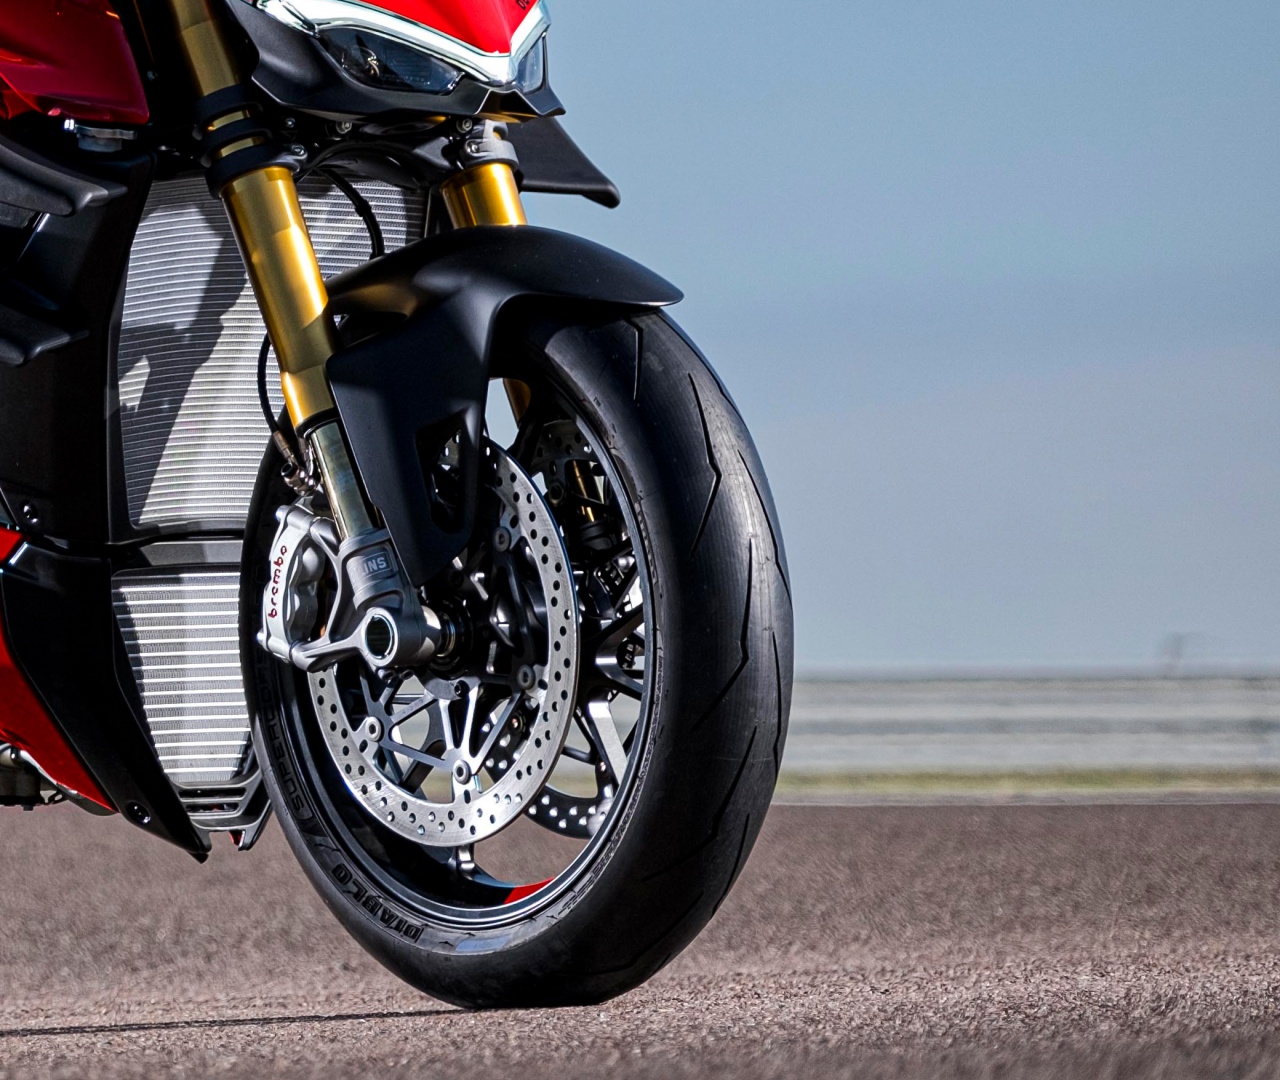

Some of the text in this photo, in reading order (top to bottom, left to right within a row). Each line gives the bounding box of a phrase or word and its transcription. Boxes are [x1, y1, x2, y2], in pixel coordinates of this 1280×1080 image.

[268, 545, 287, 618] brembo
[256, 651, 305, 812] SUPERCORS
[331, 863, 421, 942] DIABLO
